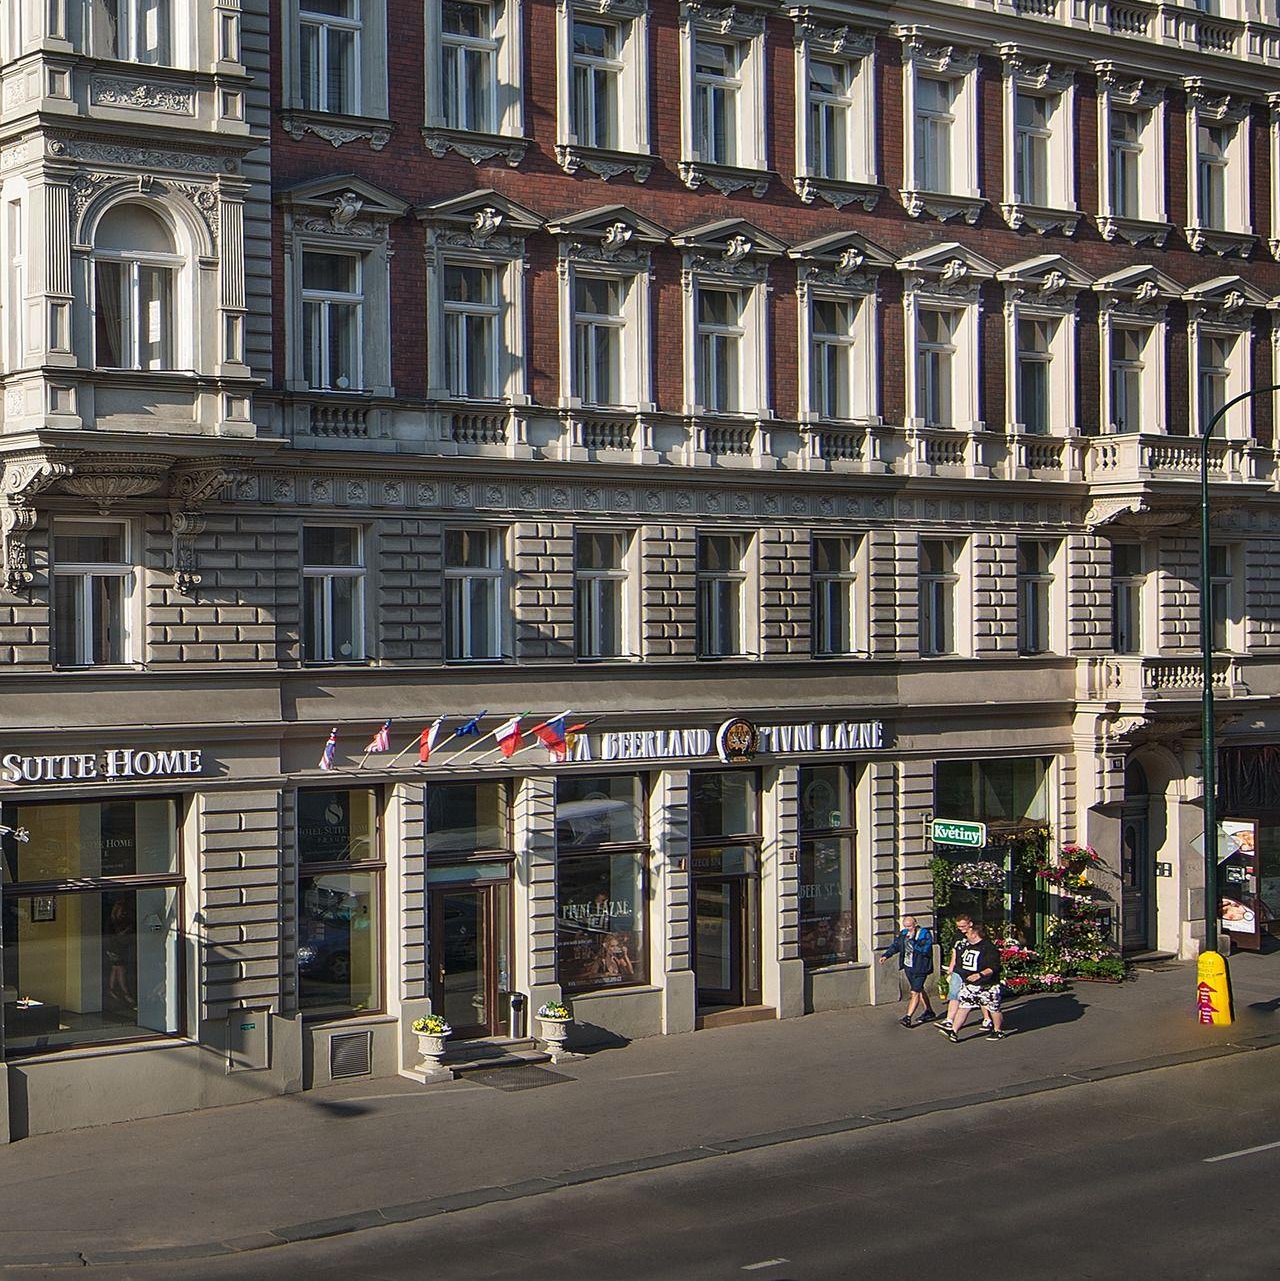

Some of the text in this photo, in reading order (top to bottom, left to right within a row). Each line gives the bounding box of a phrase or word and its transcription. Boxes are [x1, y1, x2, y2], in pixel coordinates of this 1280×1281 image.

[601, 728, 711, 760] BEERLAND
[1, 748, 202, 783] SUITE HOME
[934, 824, 980, 844] Květiny
